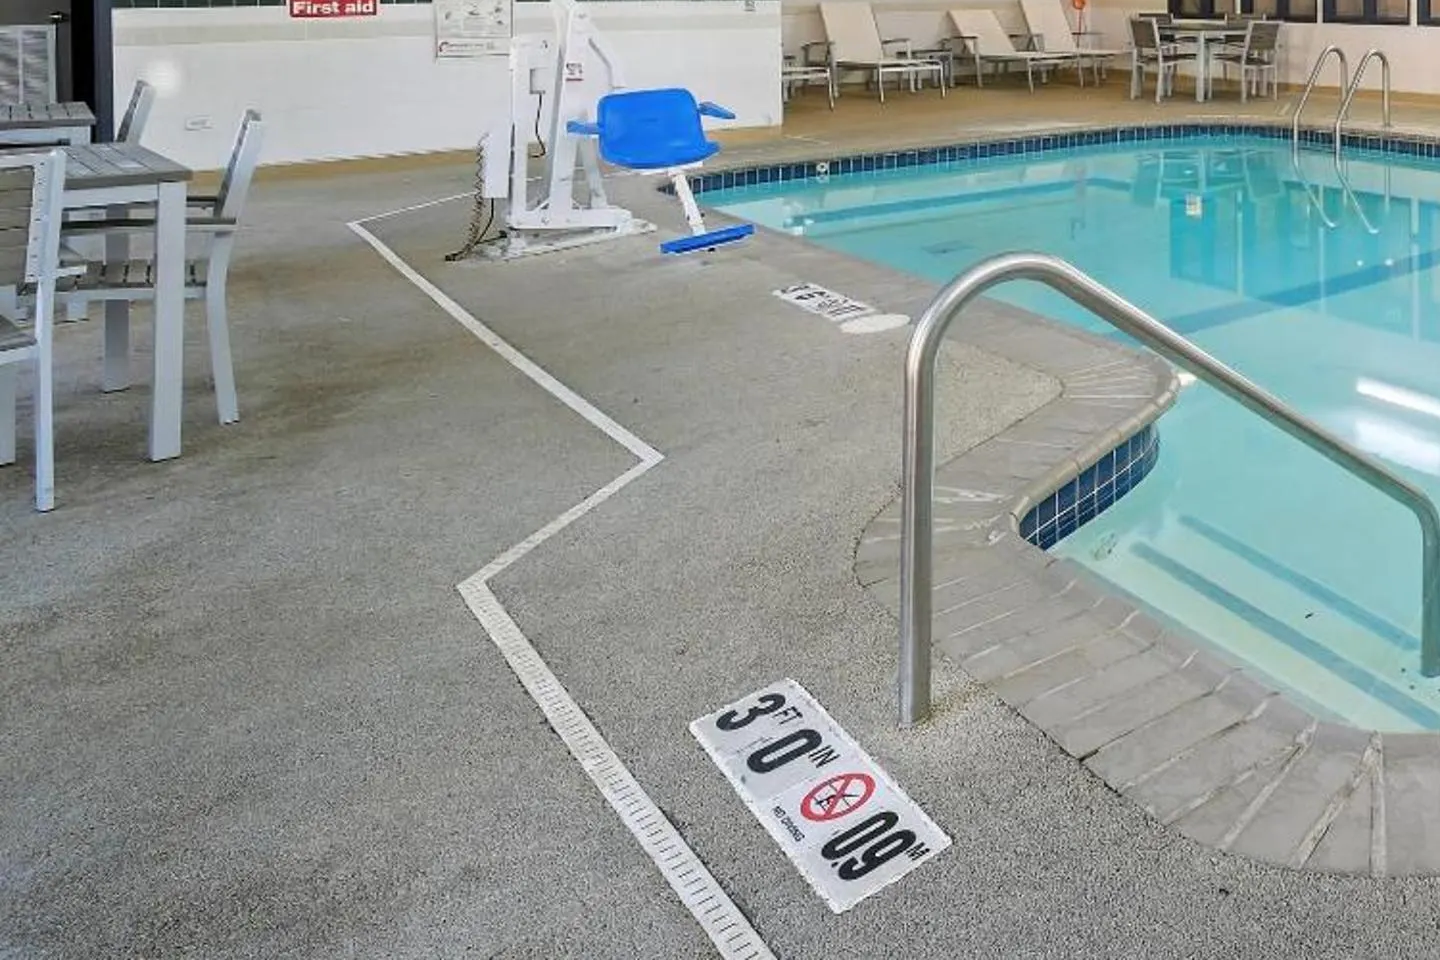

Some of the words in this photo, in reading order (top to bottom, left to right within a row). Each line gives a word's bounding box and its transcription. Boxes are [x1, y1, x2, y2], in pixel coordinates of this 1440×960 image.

[293, 0, 340, 15] First
[344, 0, 374, 14] aid
[716, 692, 786, 731] 3
[773, 705, 804, 725] FT
[746, 727, 823, 775] 0
[808, 745, 841, 769] IN
